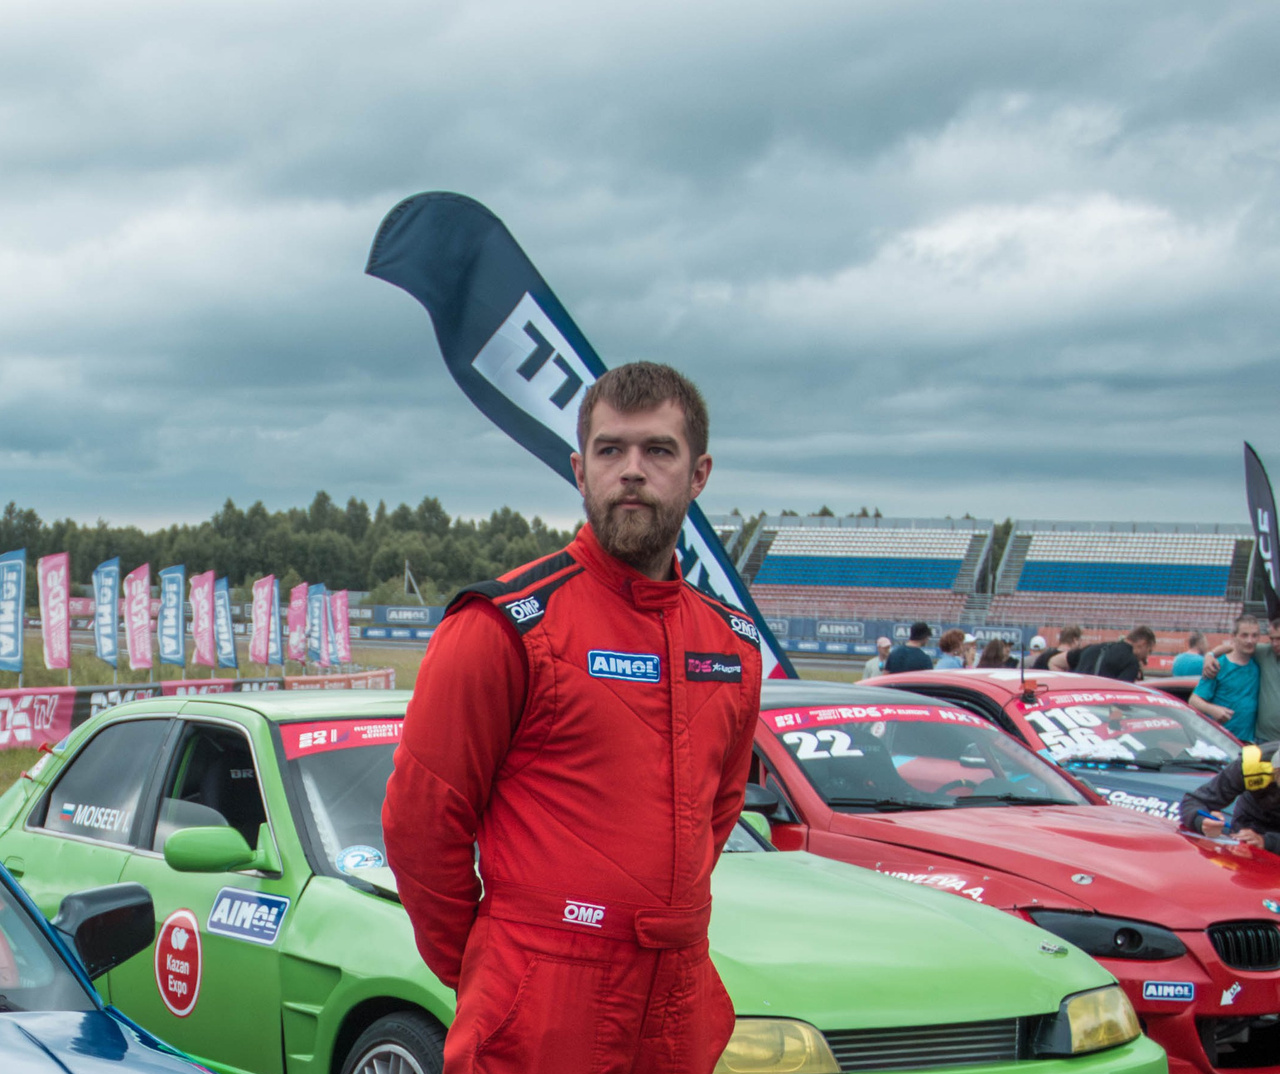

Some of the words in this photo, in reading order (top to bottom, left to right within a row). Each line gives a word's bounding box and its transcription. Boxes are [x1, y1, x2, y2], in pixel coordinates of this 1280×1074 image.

[510, 598, 540, 619] OMP
[730, 617, 758, 638] OMP
[593, 656, 658, 677] AIMOL
[838, 707, 882, 719] RDS
[938, 709, 982, 726] NXT
[1024, 706, 1103, 733] 116
[782, 729, 864, 760] 22
[1109, 790, 1168, 809] Ozolin
[73, 804, 124, 832] MOISEEV
[212, 898, 278, 935] AIMOL
[564, 904, 604, 924] OMP
[167, 954, 189, 976] Kazan
[168, 975, 188, 997] Expo
[1146, 985, 1191, 997] AIMOL
